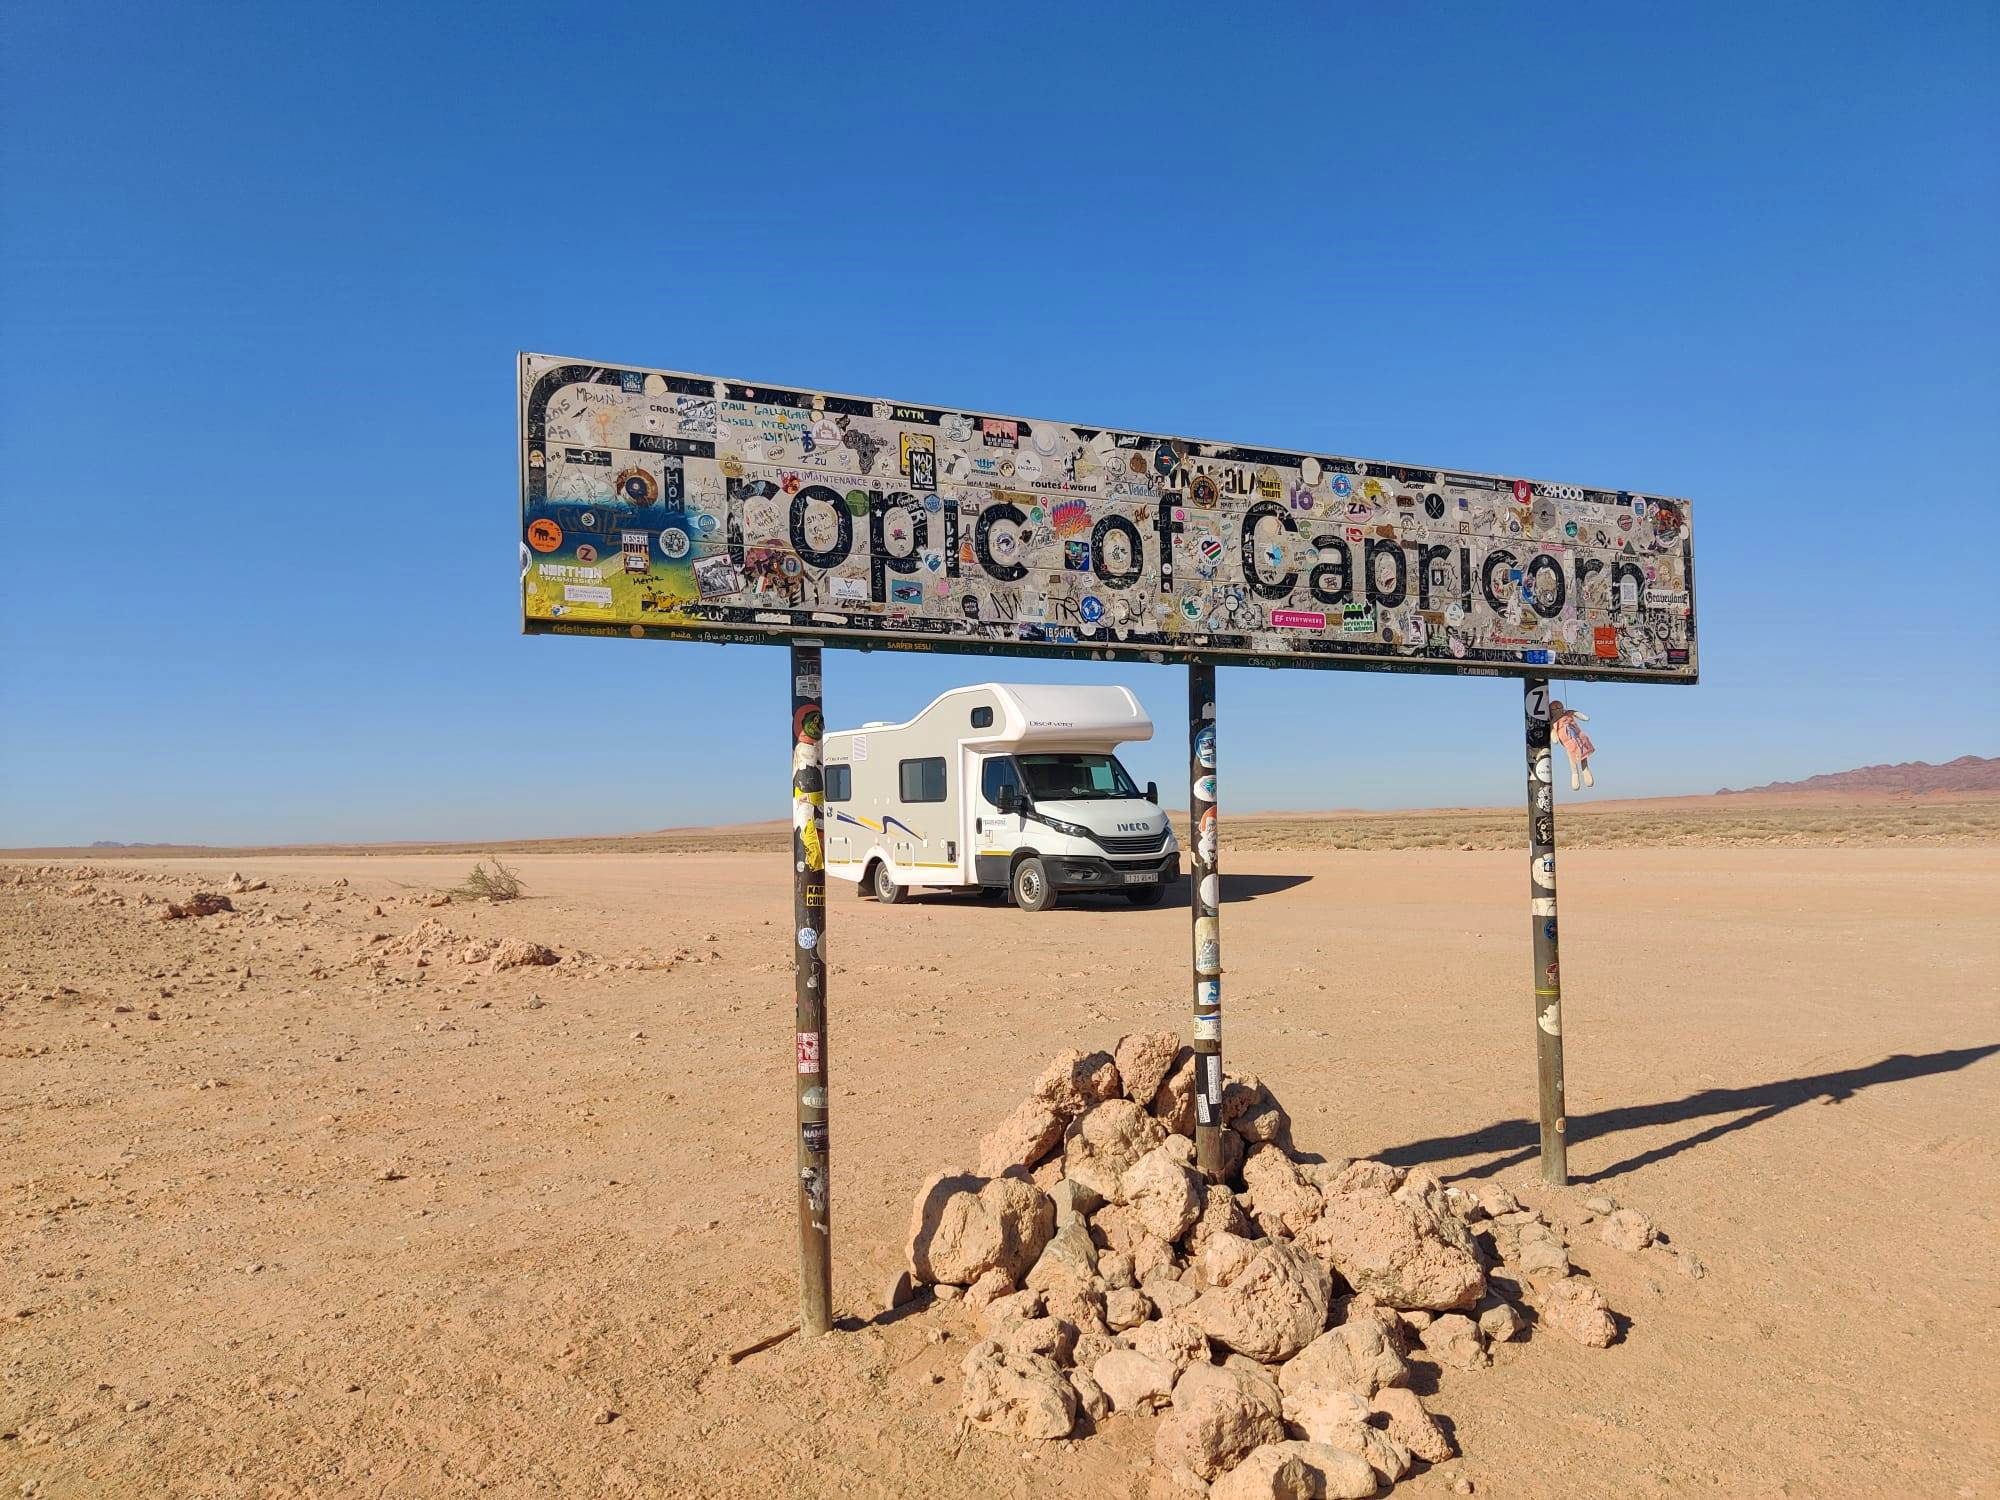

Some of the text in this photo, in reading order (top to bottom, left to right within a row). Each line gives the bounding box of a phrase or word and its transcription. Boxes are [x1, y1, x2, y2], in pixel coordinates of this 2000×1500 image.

[721, 401, 747, 411] PAUL
[1348, 502, 1368, 515] ZA
[630, 433, 1029, 604] Tropic
[1090, 491, 1184, 593] of
[1241, 500, 1647, 632] Capricorn
[622, 534, 648, 544] DESERT
[1285, 616, 1323, 625] EVERYWHERE
[1531, 690, 1546, 716] Z
[1116, 822, 1150, 832] IVECO
